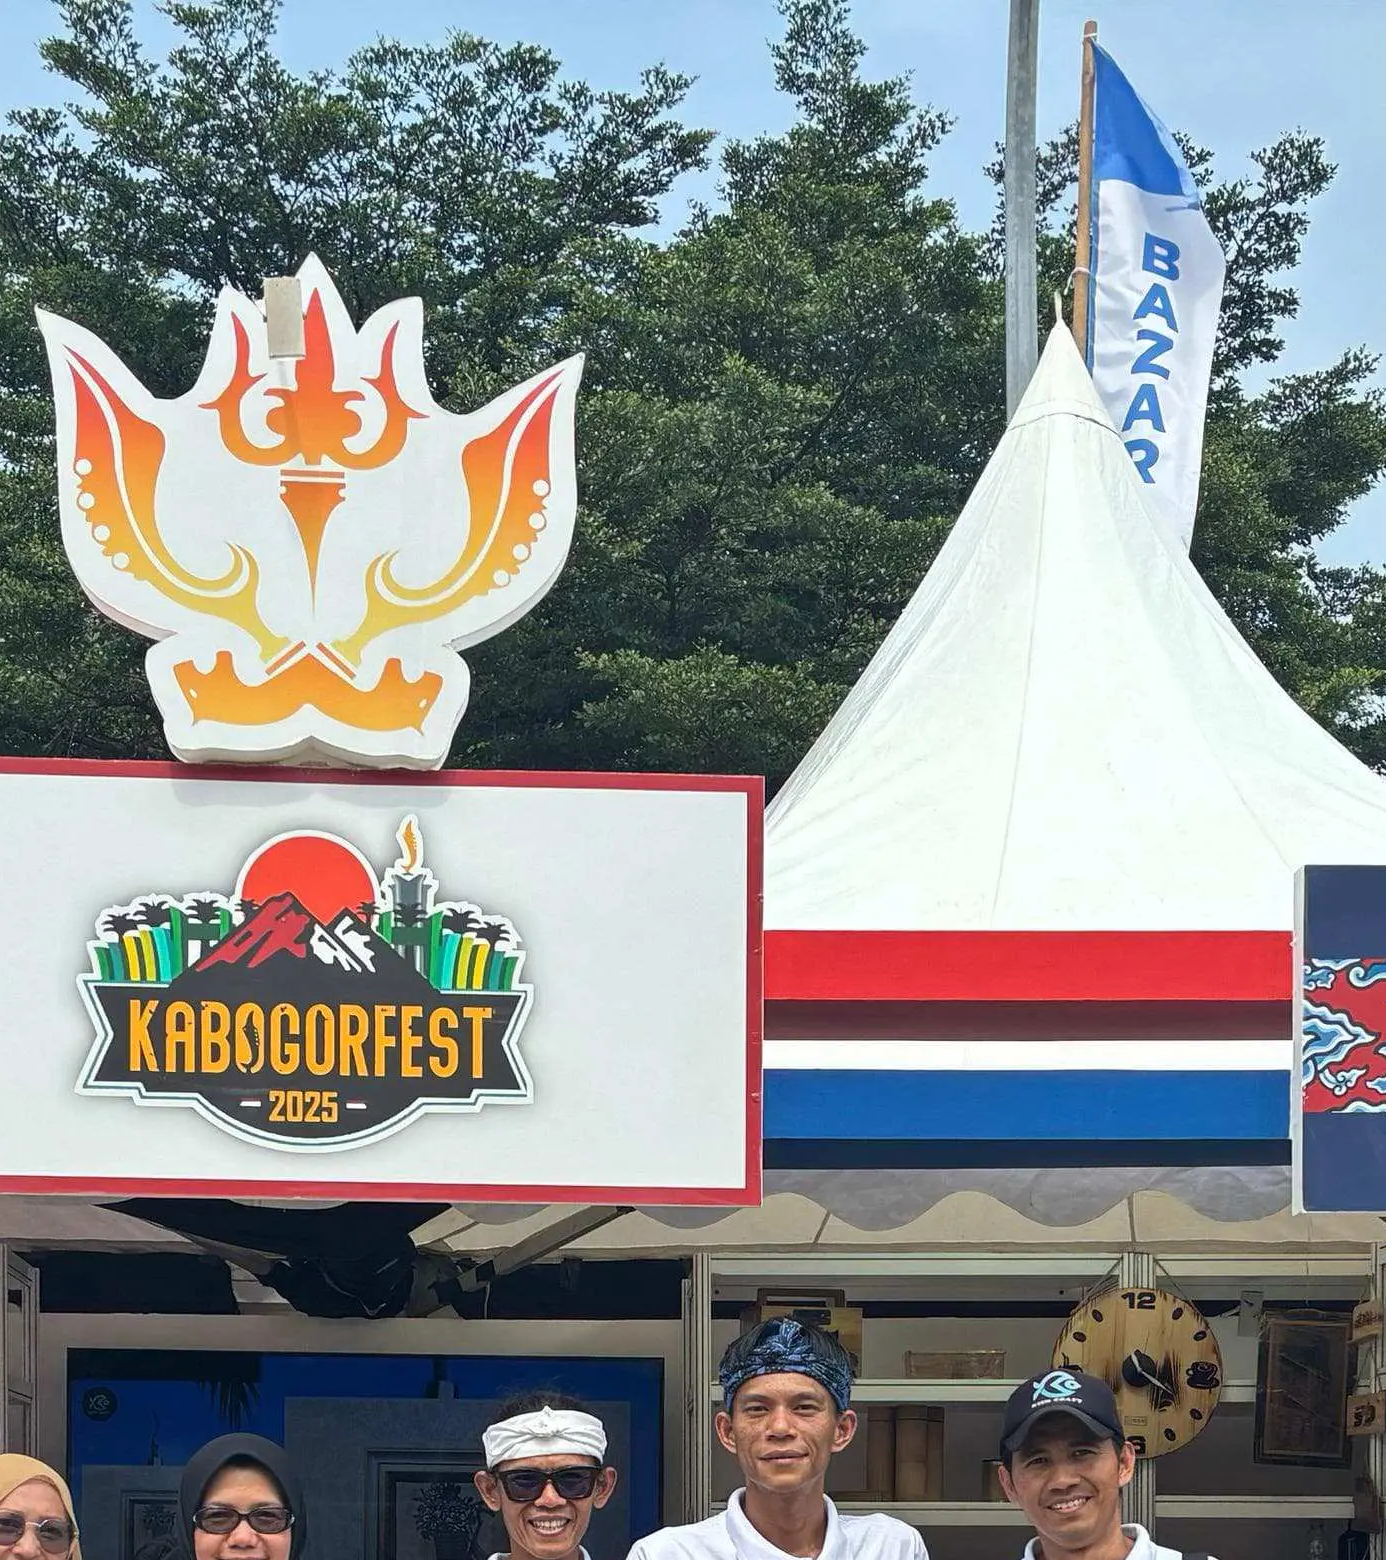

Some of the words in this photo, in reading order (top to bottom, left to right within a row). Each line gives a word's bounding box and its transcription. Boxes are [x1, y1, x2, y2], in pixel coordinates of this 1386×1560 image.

[1121, 232, 1181, 484] BAZAR
[128, 999, 493, 1079] KABOGORFEST
[268, 1090, 339, 1124] 2025
[1121, 1292, 1156, 1310] 12
